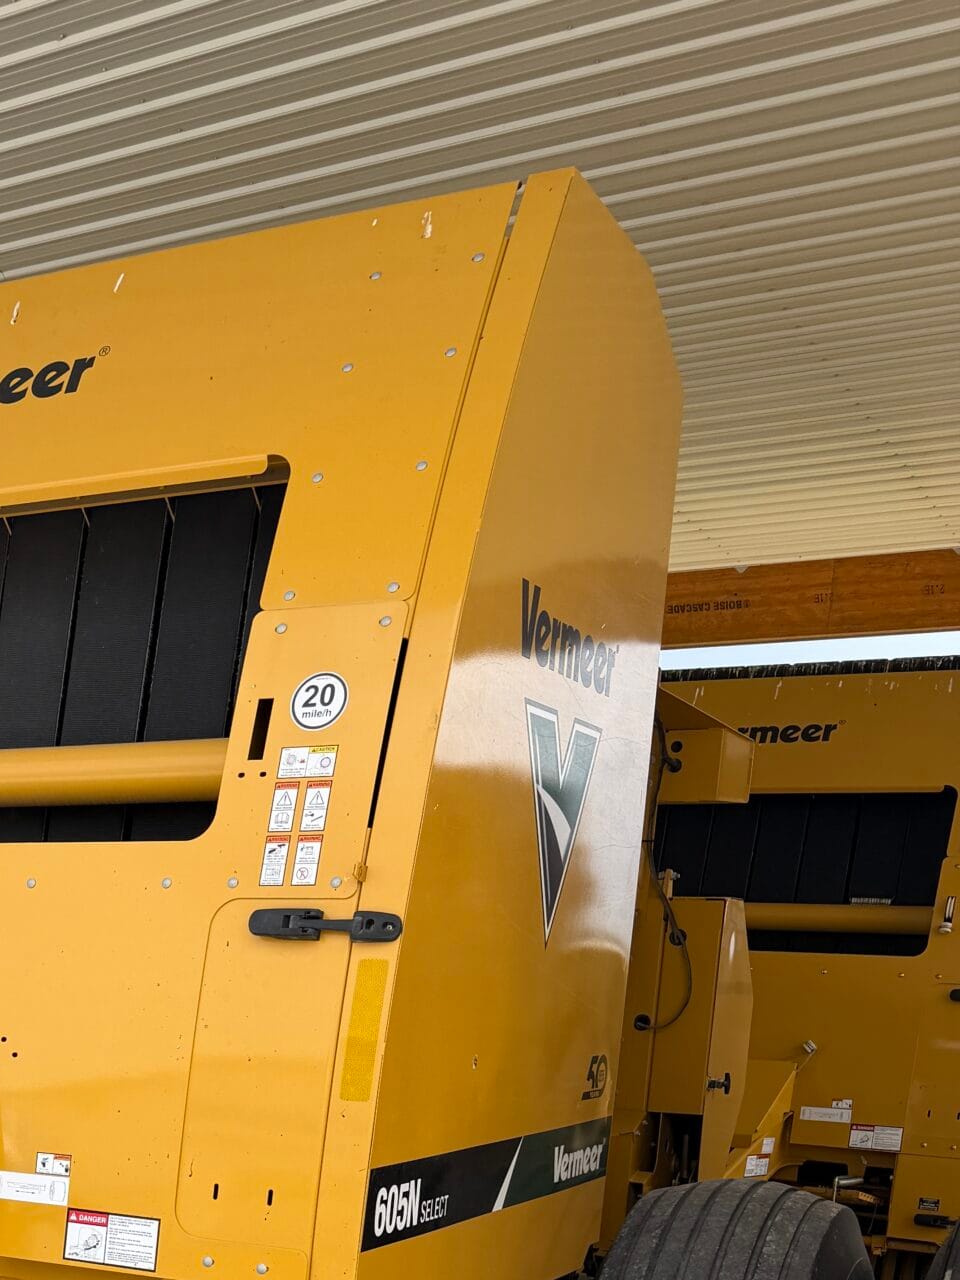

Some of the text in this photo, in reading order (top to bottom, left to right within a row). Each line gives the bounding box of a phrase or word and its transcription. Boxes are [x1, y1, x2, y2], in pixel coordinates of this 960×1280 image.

[667, 599, 742, 614] BOISE CASCADE
[522, 578, 616, 697] Vermeer
[302, 683, 336, 708] 20
[301, 709, 332, 719] mile/h
[738, 723, 838, 744] meer
[553, 1143, 603, 1183] Vermeer
[79, 1213, 107, 1224] DANGER
[374, 1178, 450, 1238] 605N SELECT
